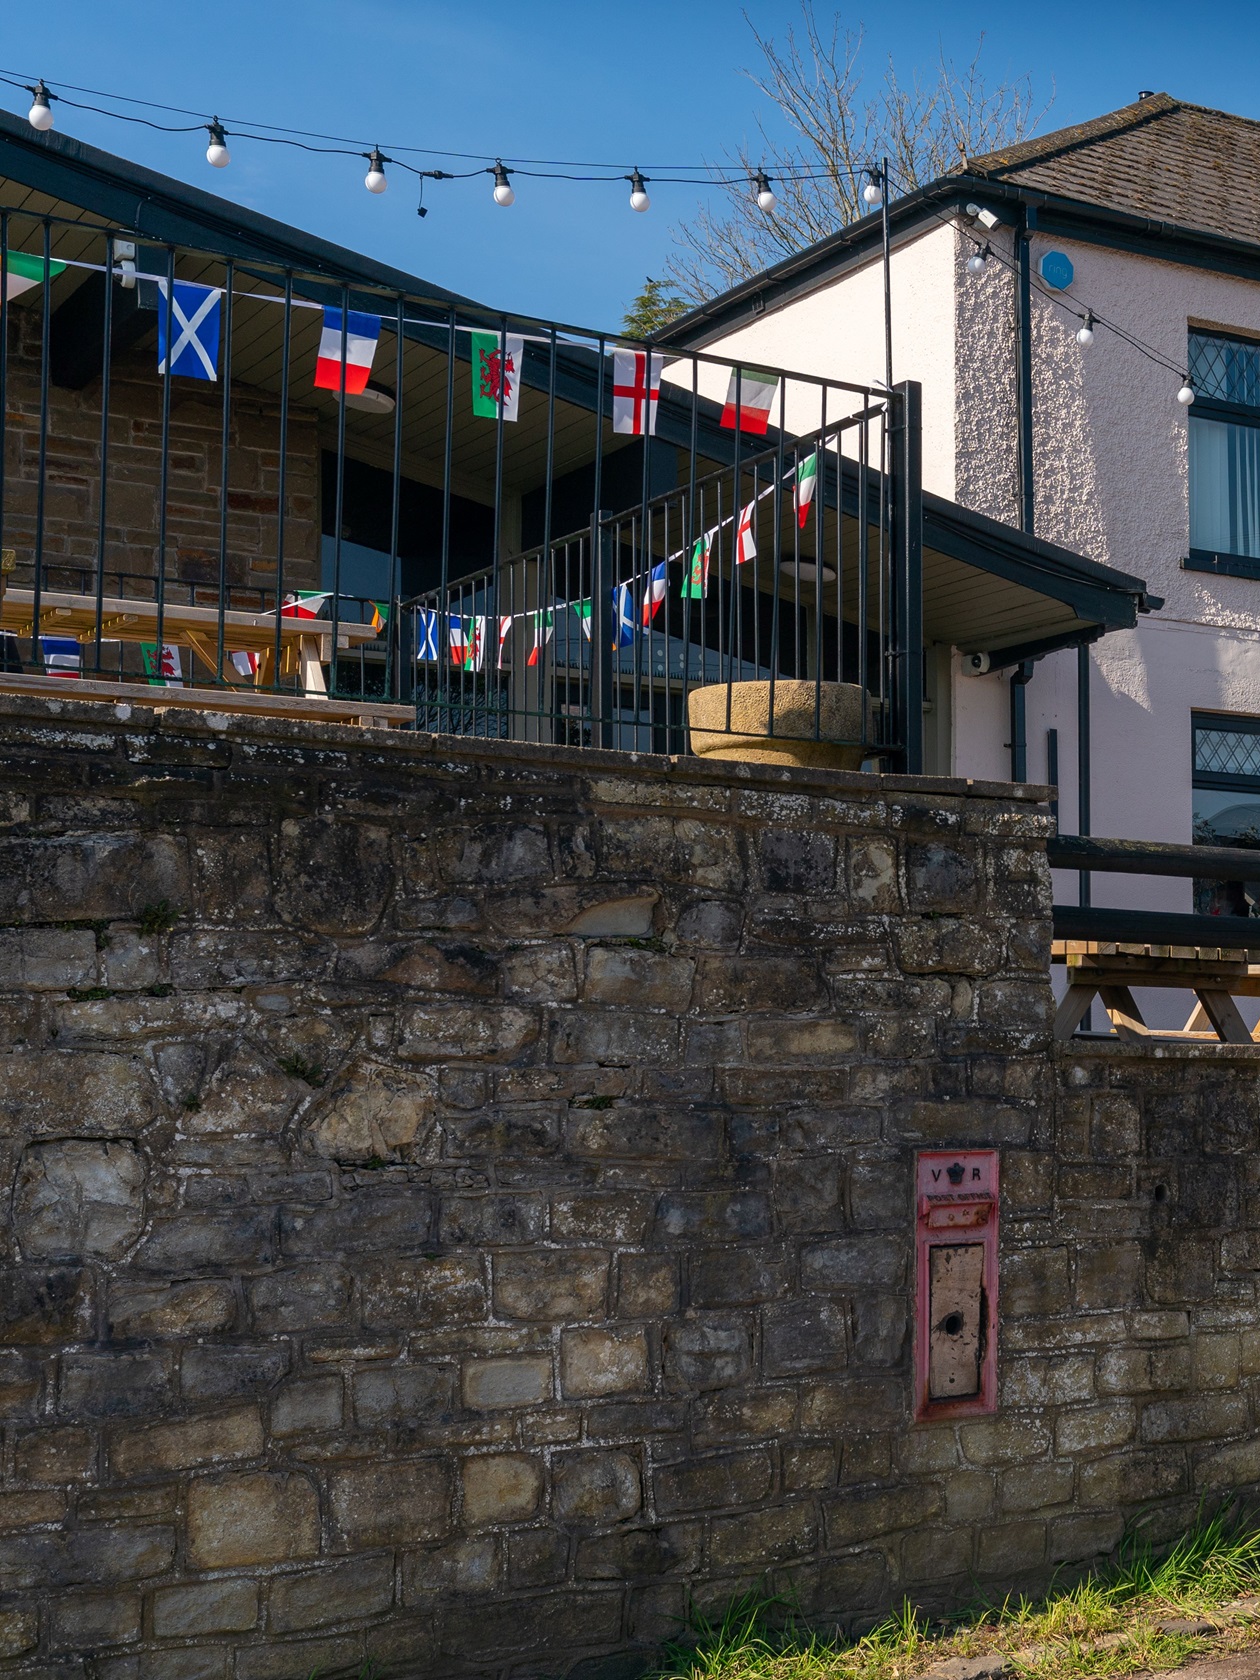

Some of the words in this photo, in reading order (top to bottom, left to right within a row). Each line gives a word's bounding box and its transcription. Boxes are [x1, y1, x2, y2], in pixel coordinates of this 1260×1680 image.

[1048, 264, 1068, 279] ring
[931, 1169, 942, 1182] V
[972, 1168, 981, 1180] R
